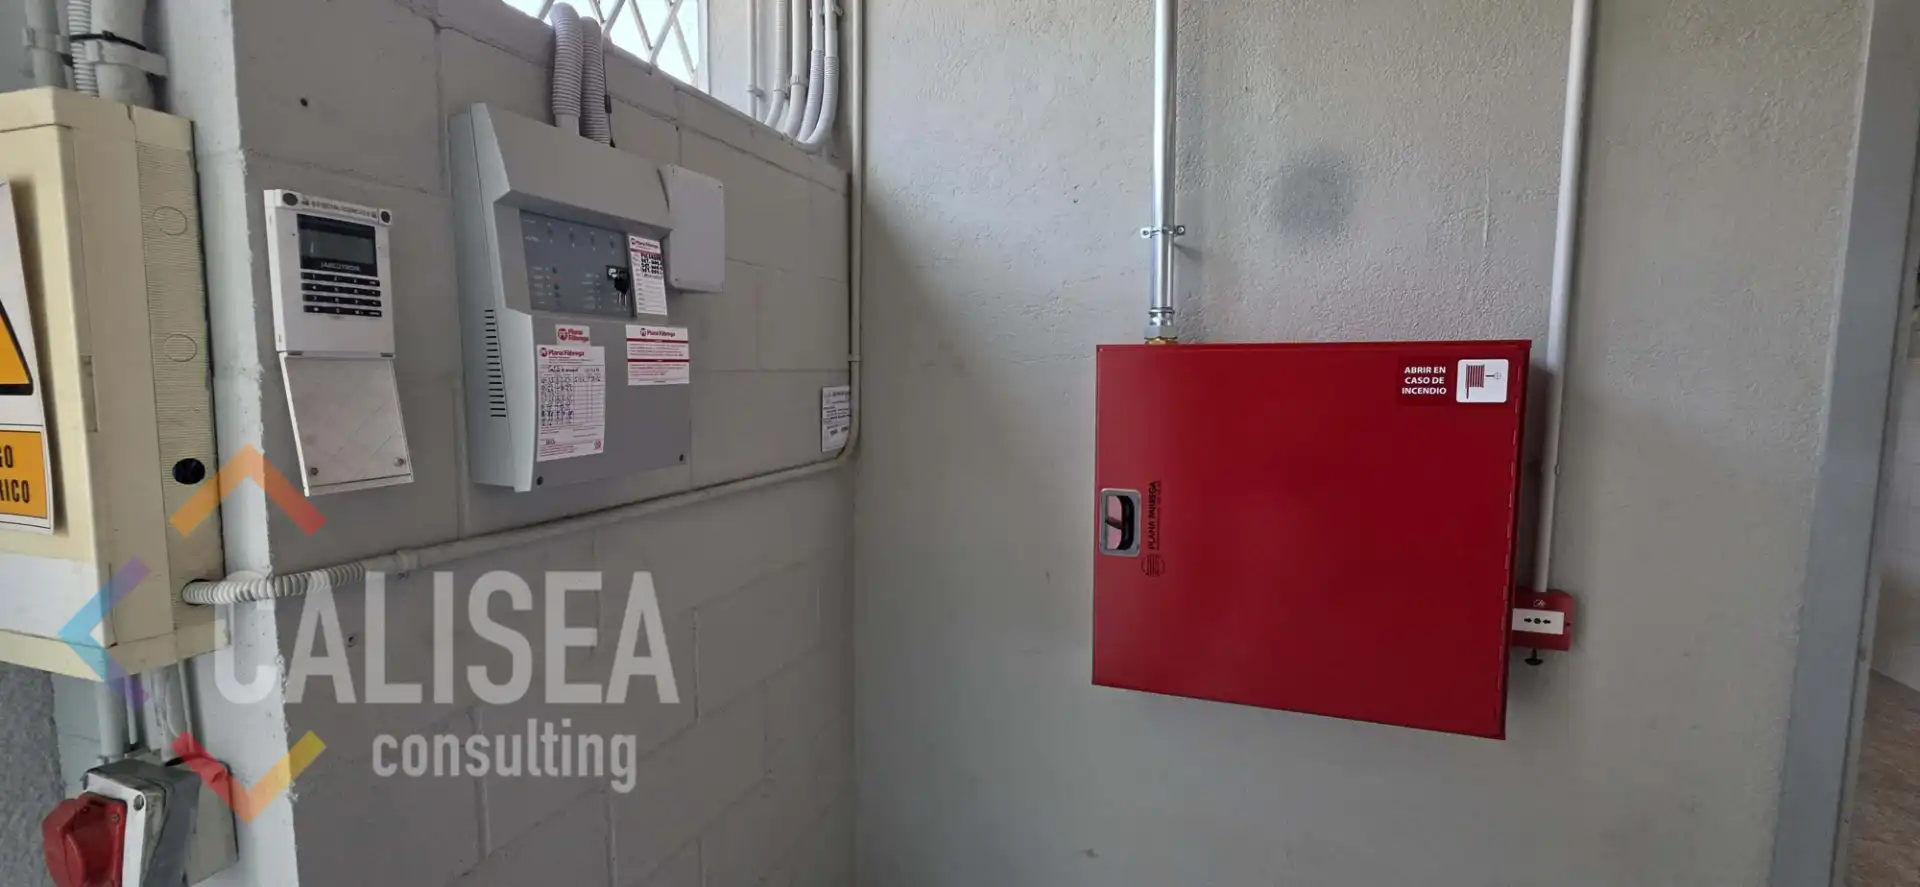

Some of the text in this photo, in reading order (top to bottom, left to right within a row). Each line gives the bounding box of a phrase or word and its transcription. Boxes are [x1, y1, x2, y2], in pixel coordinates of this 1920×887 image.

[1404, 366, 1446, 374] ABRIR EN
[1404, 376, 1445, 385] CASO DE
[1401, 387, 1447, 395] INCENDIO
